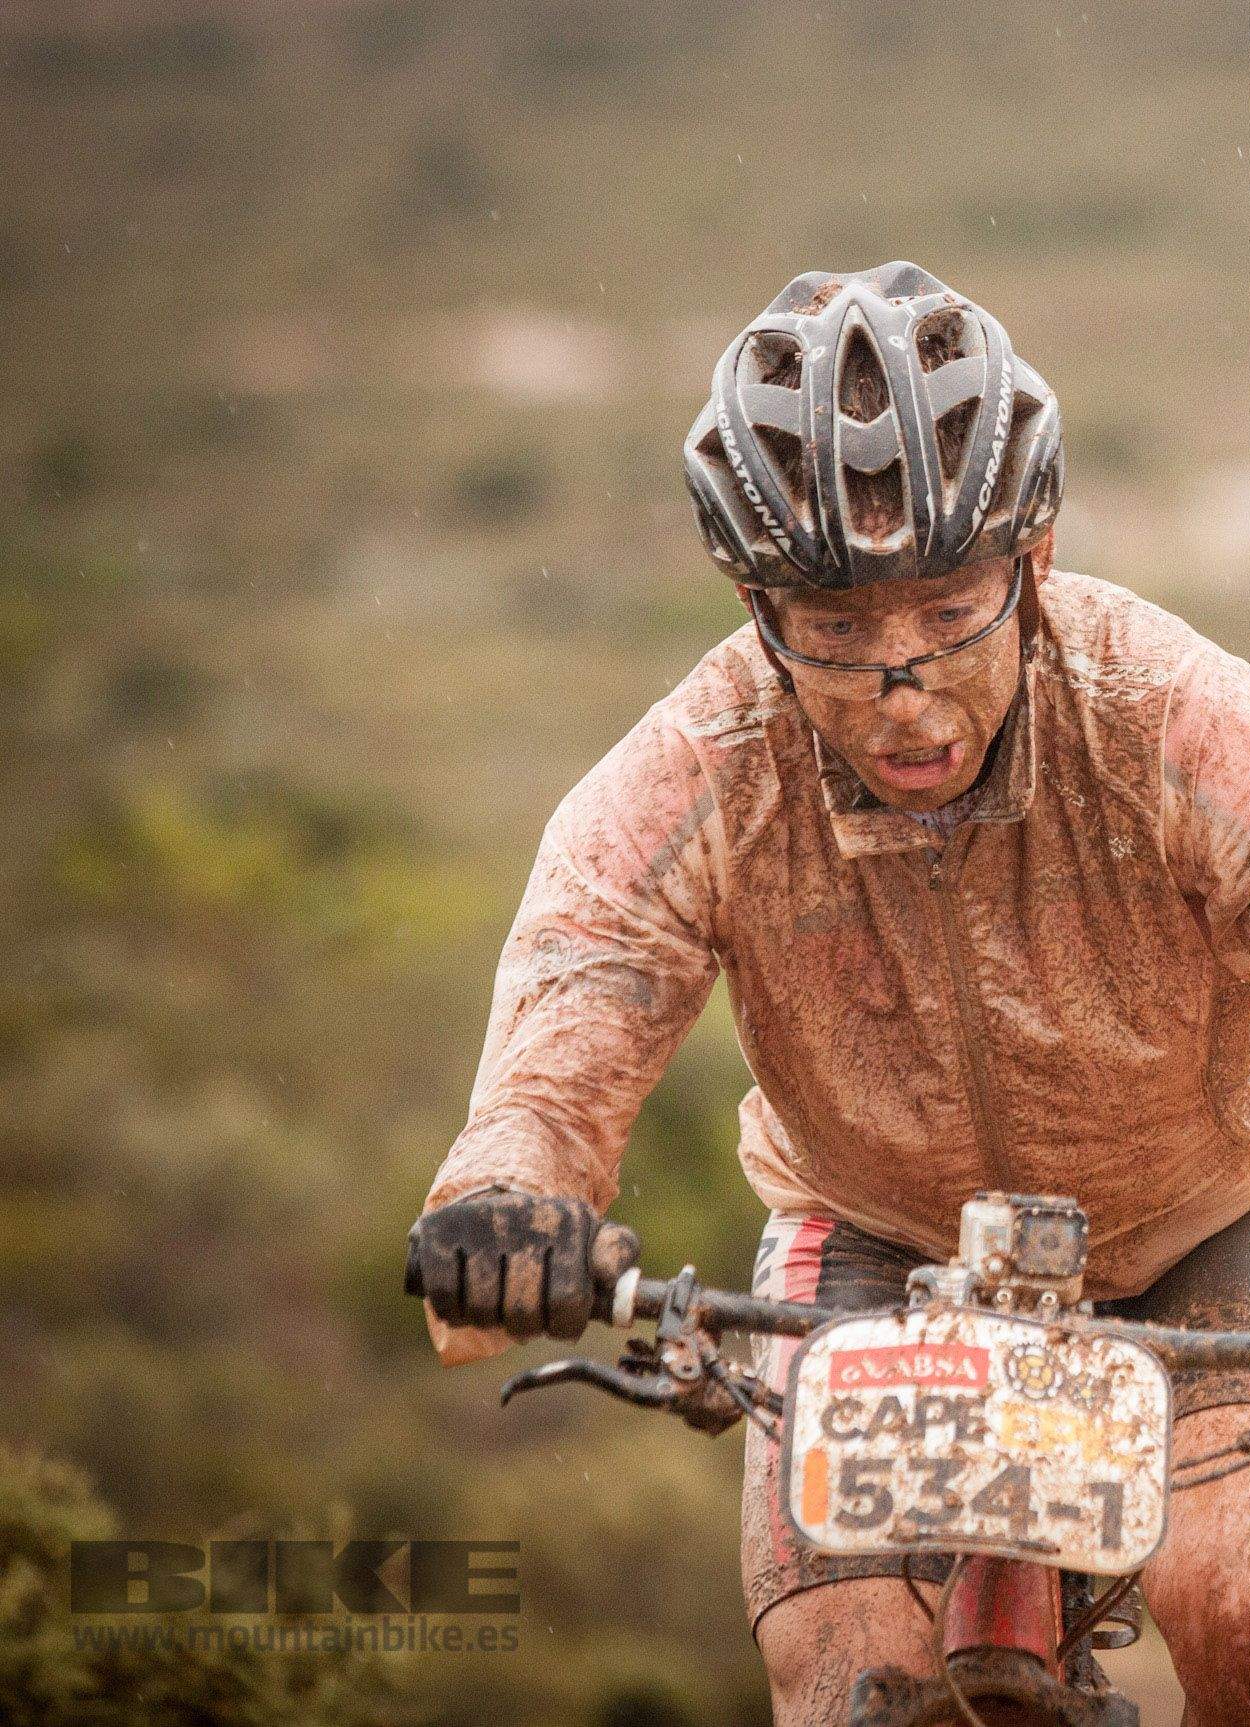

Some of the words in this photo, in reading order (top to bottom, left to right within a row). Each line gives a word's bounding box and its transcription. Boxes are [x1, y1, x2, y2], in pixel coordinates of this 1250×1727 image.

[717, 411, 784, 538] CRATONI
[978, 366, 1012, 510] CRATONI
[820, 1394, 986, 1442] CAPE
[833, 1457, 1124, 1551] 534-1
